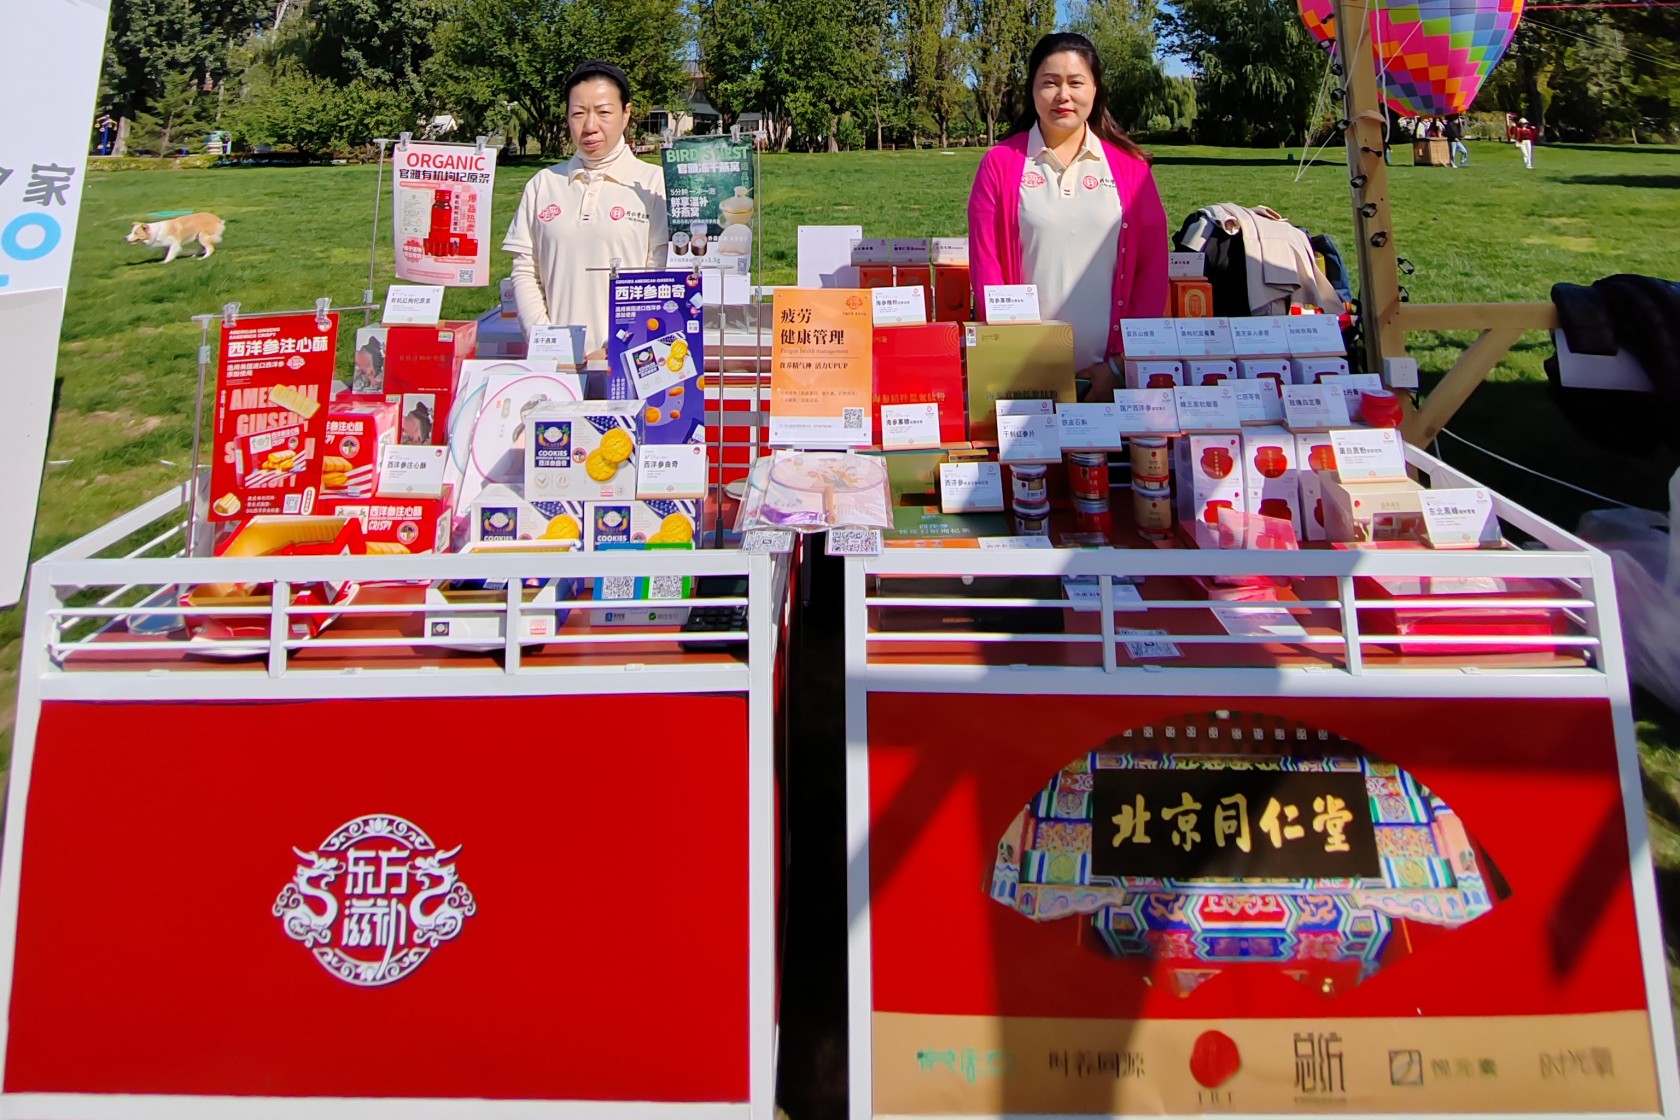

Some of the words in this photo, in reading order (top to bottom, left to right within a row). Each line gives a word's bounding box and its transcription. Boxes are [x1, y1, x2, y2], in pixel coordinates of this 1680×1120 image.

[406, 152, 486, 171] ORGANIC
[615, 284, 686, 300] 西洋参曲奇
[781, 308, 812, 324] 疲劳
[781, 329, 845, 345] 健康管理
[228, 336, 328, 358] 西洋参注心酥
[643, 460, 679, 469] 西洋参曲奇
[370, 506, 423, 517] 西洋参注心酥
[368, 520, 393, 531] CRISPY
[1111, 791, 1354, 853] 北京同仁堂
[345, 846, 410, 895] 东方
